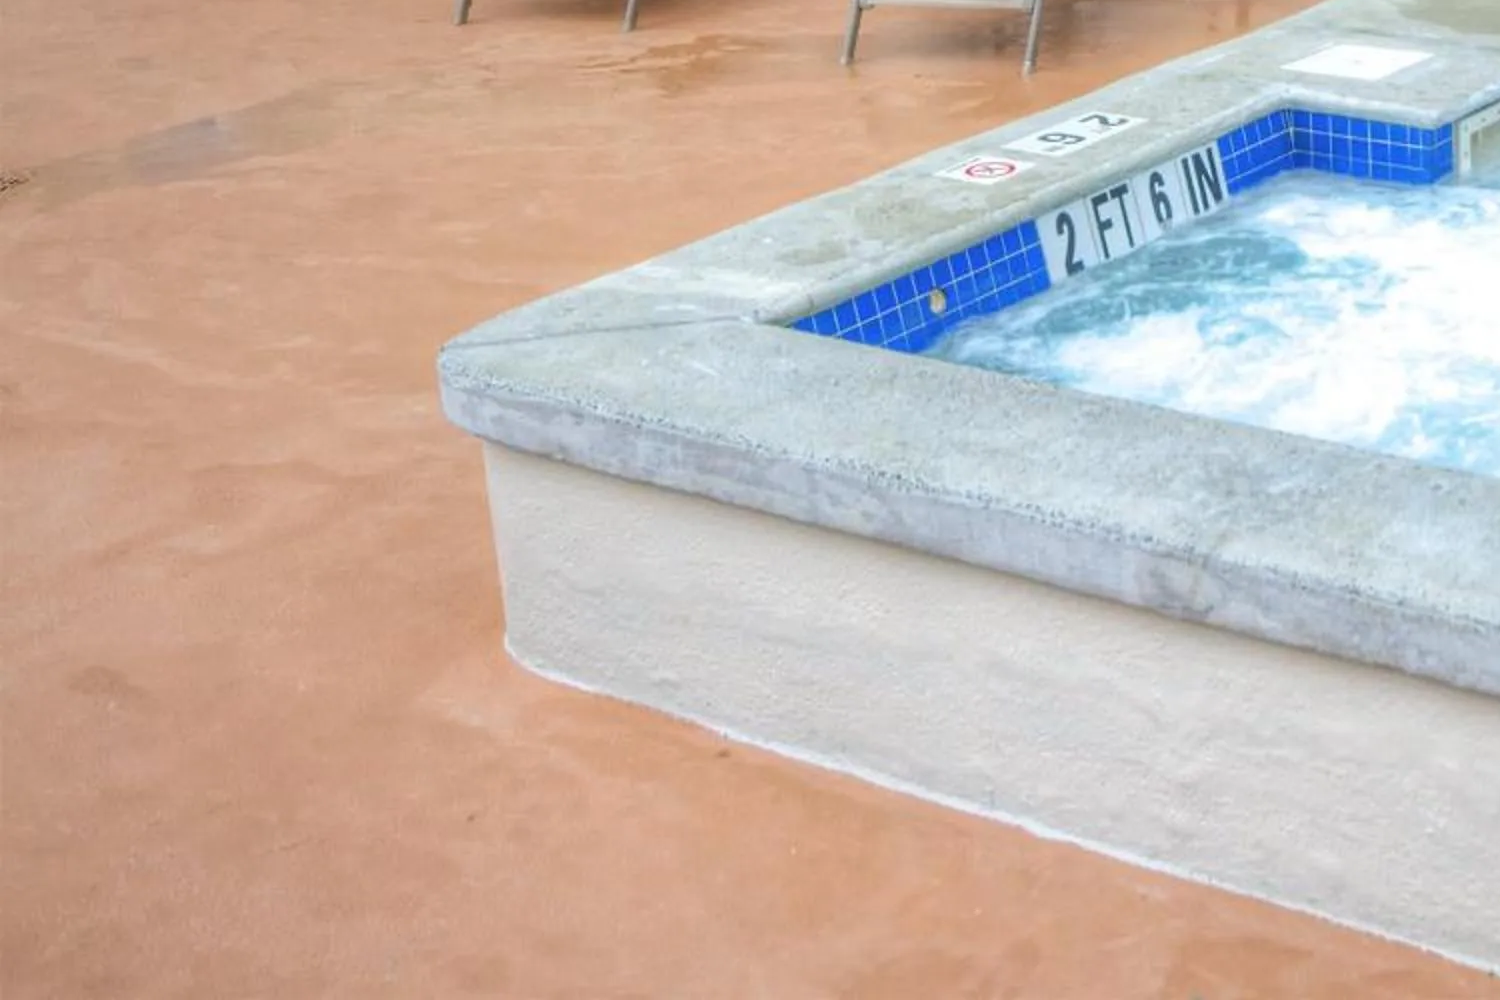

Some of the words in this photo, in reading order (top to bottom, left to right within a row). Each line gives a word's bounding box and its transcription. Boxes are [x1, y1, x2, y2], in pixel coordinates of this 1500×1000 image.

[1055, 210, 1085, 277] 2
[1091, 182, 1135, 260] FT
[1149, 171, 1174, 225] 6
[1181, 147, 1223, 215] IN
